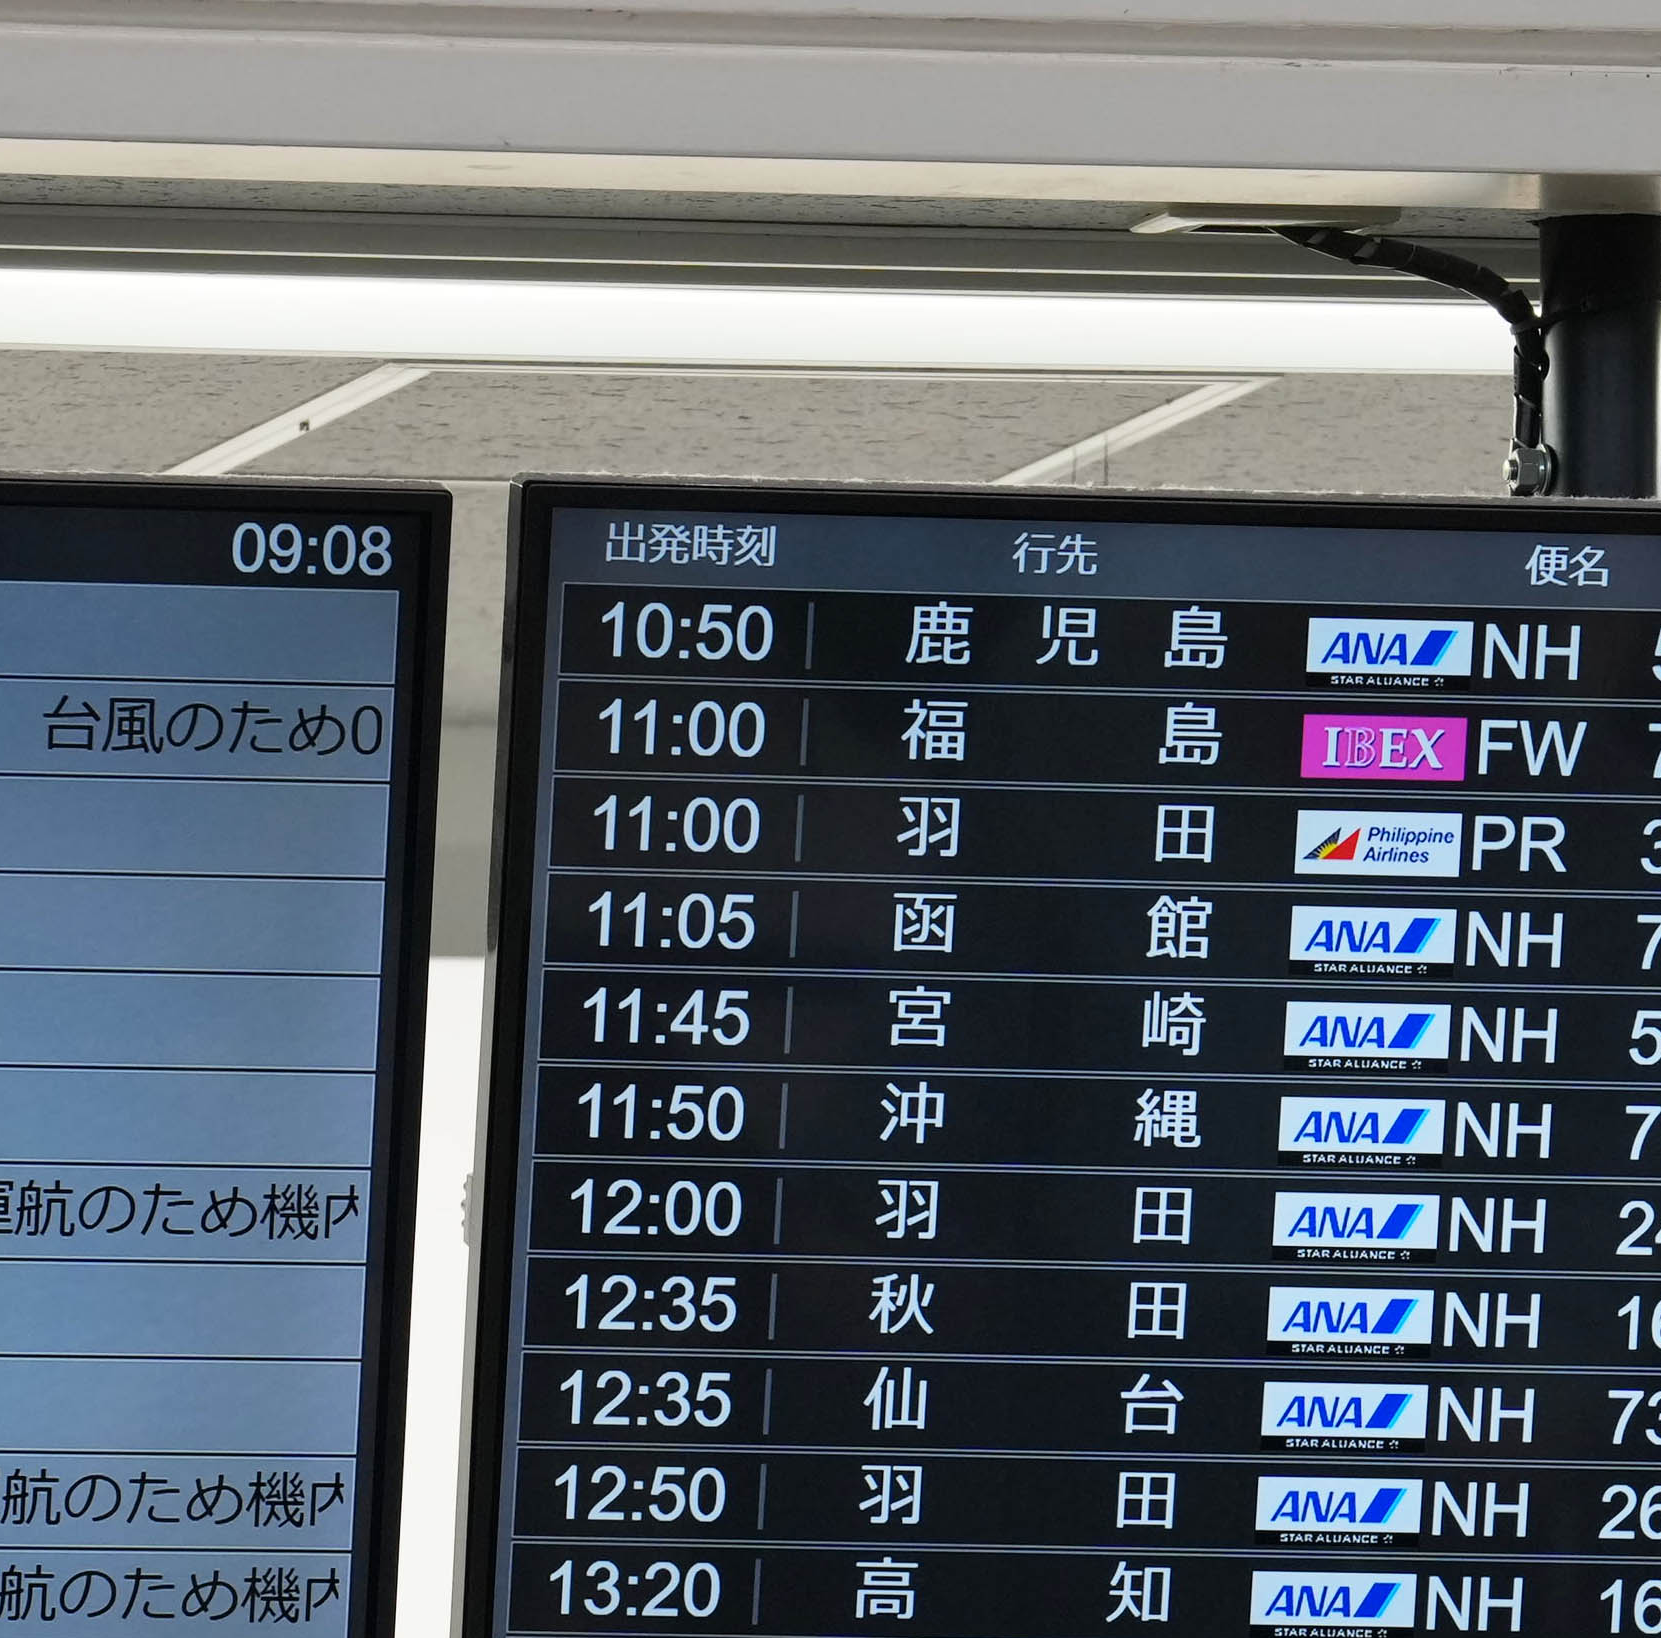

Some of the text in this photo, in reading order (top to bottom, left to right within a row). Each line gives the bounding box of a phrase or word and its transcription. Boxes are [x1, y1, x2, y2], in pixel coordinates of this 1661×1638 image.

[232, 522, 392, 576] 09:08
[605, 521, 777, 567] 出発時刻
[1012, 532, 1098, 575] 行先
[1524, 544, 1609, 587] 便名
[601, 601, 774, 661] 10:50
[1321, 632, 1408, 666] ANA
[1482, 623, 1581, 681] NH
[42, 694, 383, 756] 台風のため0
[598, 698, 766, 758] 11:00
[1322, 727, 1446, 769] IBEX
[1477, 719, 1588, 777] FW
[593, 794, 760, 854] 11:00
[1367, 827, 1454, 845] Philippine
[1471, 815, 1567, 873] PR
[1363, 847, 1429, 863] Airlines
[588, 890, 755, 950] 11:05
[1305, 920, 1390, 954] ANA
[1465, 910, 1564, 969] NH
[583, 986, 750, 1046] 11:45
[1299, 1015, 1385, 1048] ANA
[1460, 1006, 1558, 1064] NH
[578, 1082, 745, 1142] 11:50
[1293, 1111, 1379, 1144] ANA
[1454, 1101, 1552, 1159] NH
[570, 1178, 742, 1237] 12:00
[1288, 1205, 1374, 1239] ANA
[1448, 1196, 1547, 1254] NH
[565, 1273, 737, 1333] 12:35
[1282, 1300, 1368, 1334] ANA
[1443, 1291, 1541, 1349] NH
[560, 1369, 731, 1428] 12:35
[1277, 1396, 1362, 1430] ANA
[1437, 1386, 1535, 1443] NH
[554, 1464, 726, 1523] 12:50
[1271, 1490, 1357, 1524] ANA
[1431, 1481, 1529, 1538] NH
[549, 1559, 721, 1618] 13:20
[1265, 1585, 1351, 1618] ANA
[1425, 1575, 1524, 1632] NH
